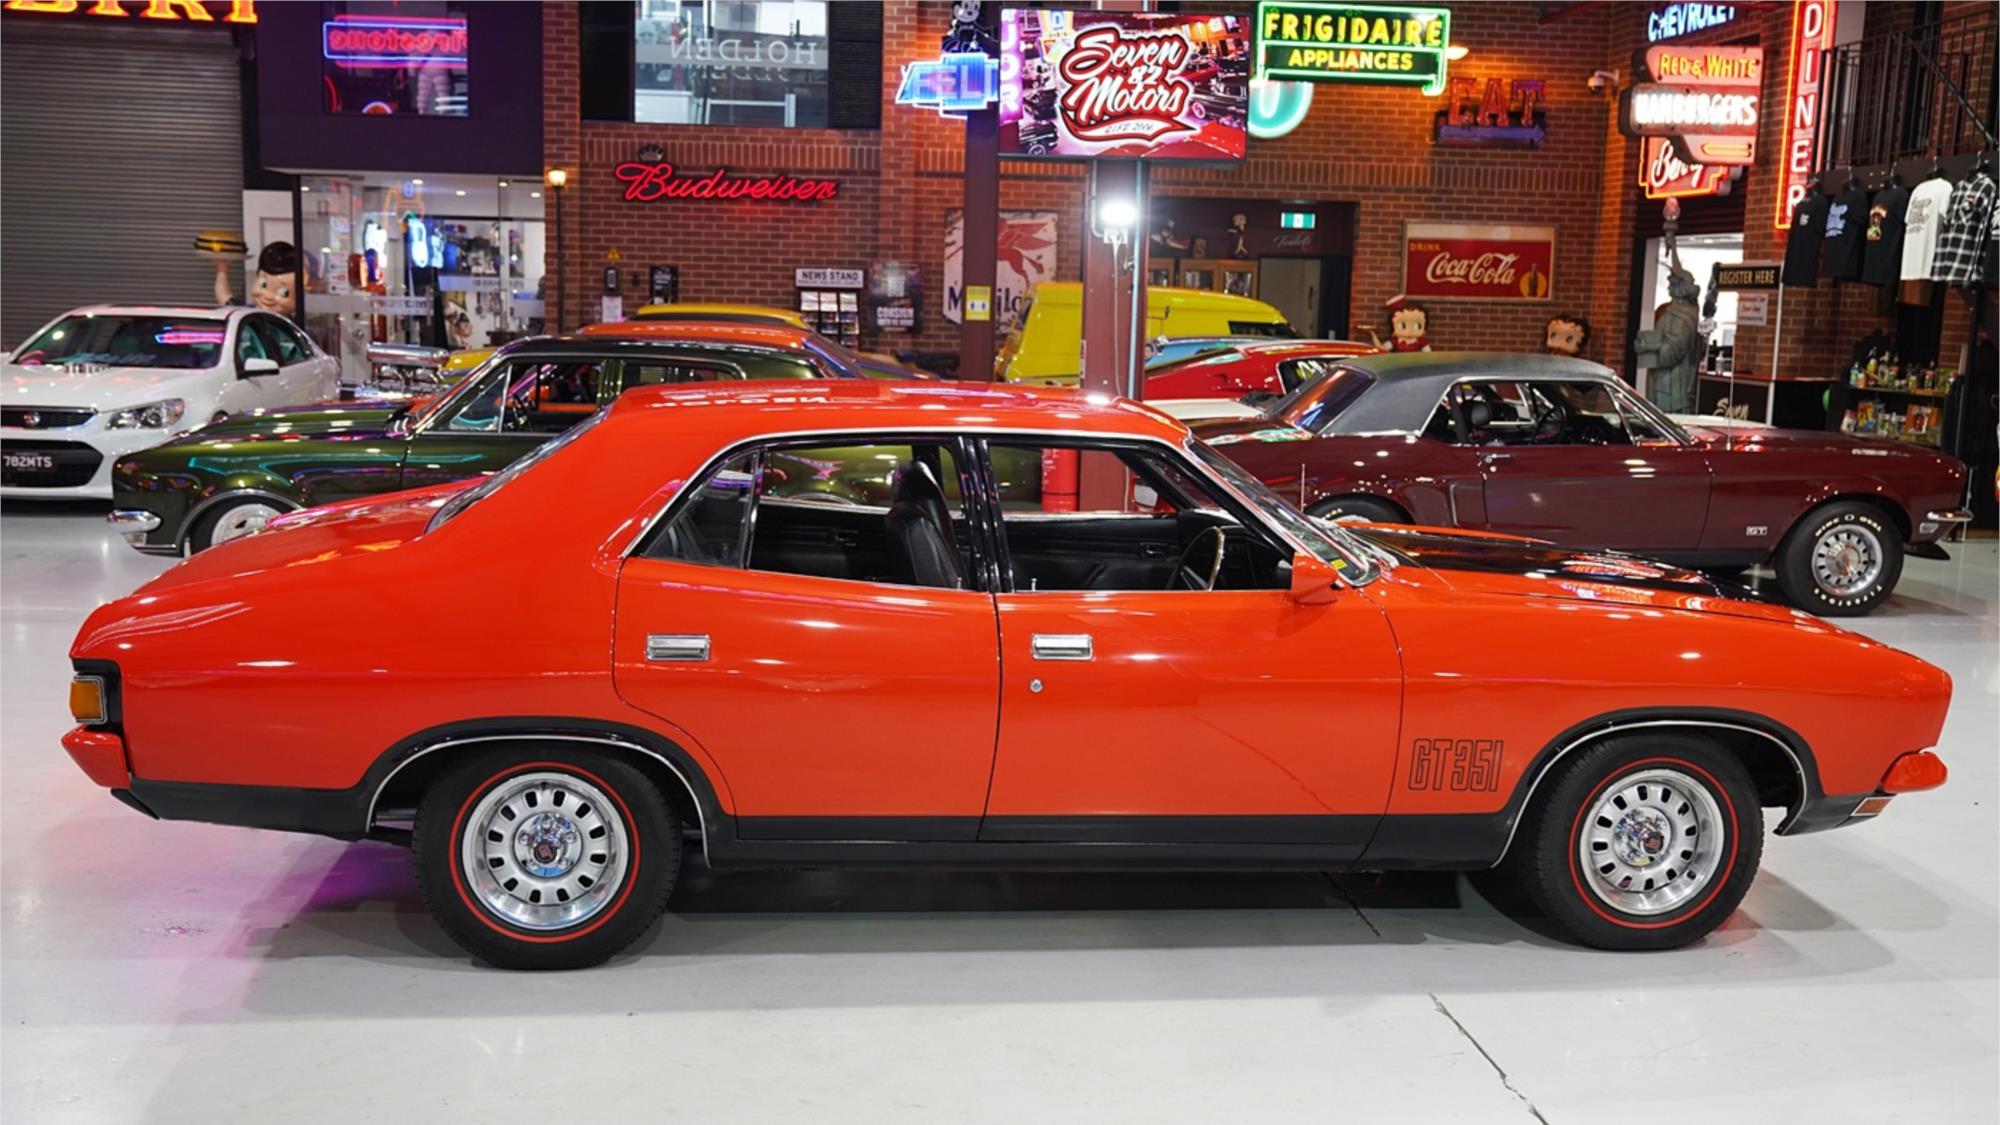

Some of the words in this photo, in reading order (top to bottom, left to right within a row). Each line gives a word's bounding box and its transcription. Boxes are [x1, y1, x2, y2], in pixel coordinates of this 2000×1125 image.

[1264, 12, 1443, 46] FRIGIDAIRE
[1065, 33, 1183, 80] Seven
[1288, 49, 1413, 70] APPLIANCES
[1660, 54, 1689, 76] RED
[1705, 54, 1757, 78] WHITE
[911, 65, 997, 99] FELI
[1066, 76, 1184, 121] Motors
[1449, 77, 1545, 127] EAT
[1634, 93, 1759, 125] HAMBURGERS
[1786, 3, 1823, 218] DINER
[615, 162, 837, 201] Budweiser
[1410, 243, 1440, 251] DRINK
[802, 271, 827, 280] NEWS
[830, 271, 859, 280] STAND
[1426, 252, 1519, 284] Coca-Cola
[1720, 270, 1753, 284] REGISTER
[1755, 269, 1775, 284] HERE
[1746, 526, 1768, 536] GT
[1408, 738, 1504, 792] GT351
